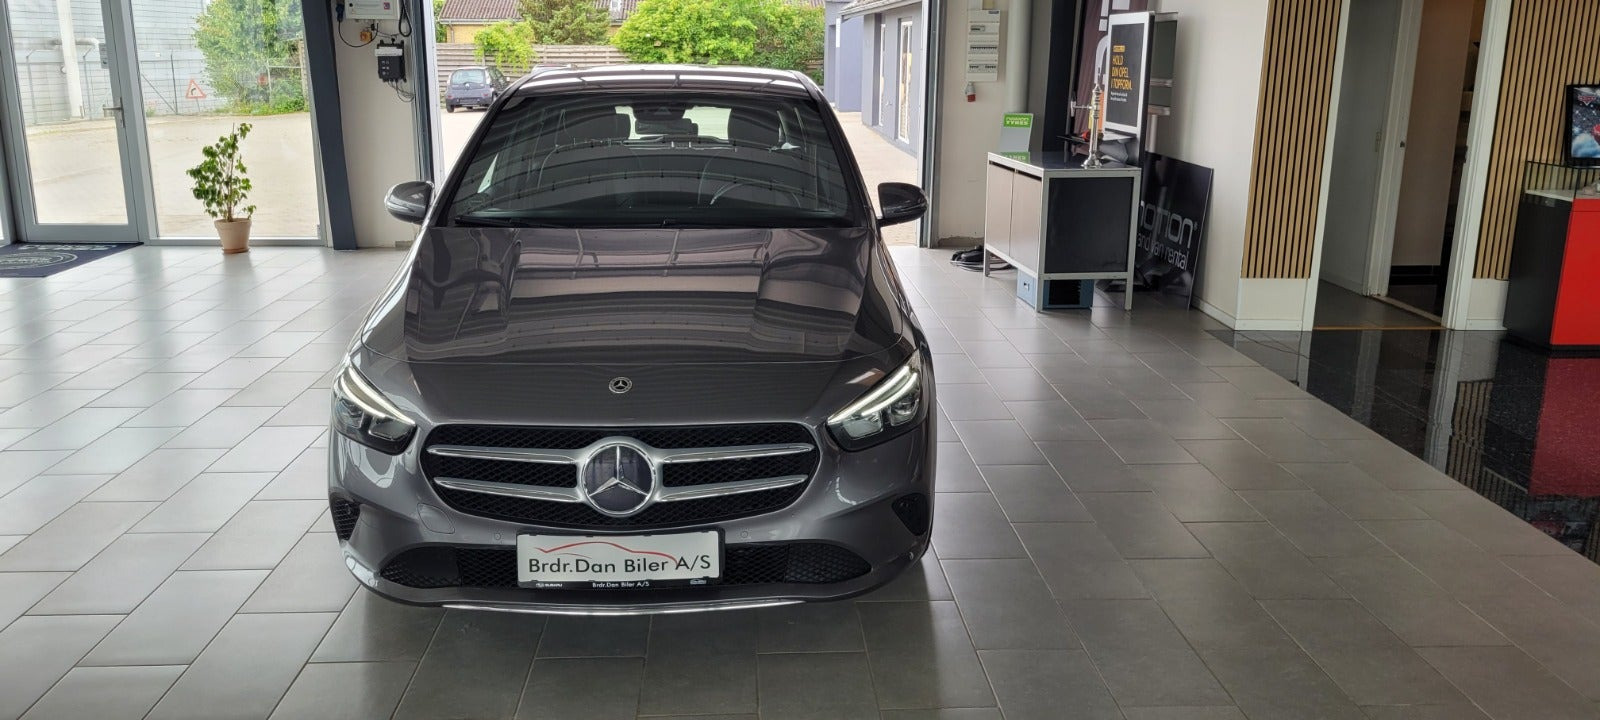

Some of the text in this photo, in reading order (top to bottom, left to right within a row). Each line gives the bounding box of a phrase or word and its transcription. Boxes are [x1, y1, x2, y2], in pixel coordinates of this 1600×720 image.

[1119, 67, 1129, 78] OPEL
[1164, 246, 1190, 271] rental
[528, 554, 711, 573] Brdr.Dan Biler A/S
